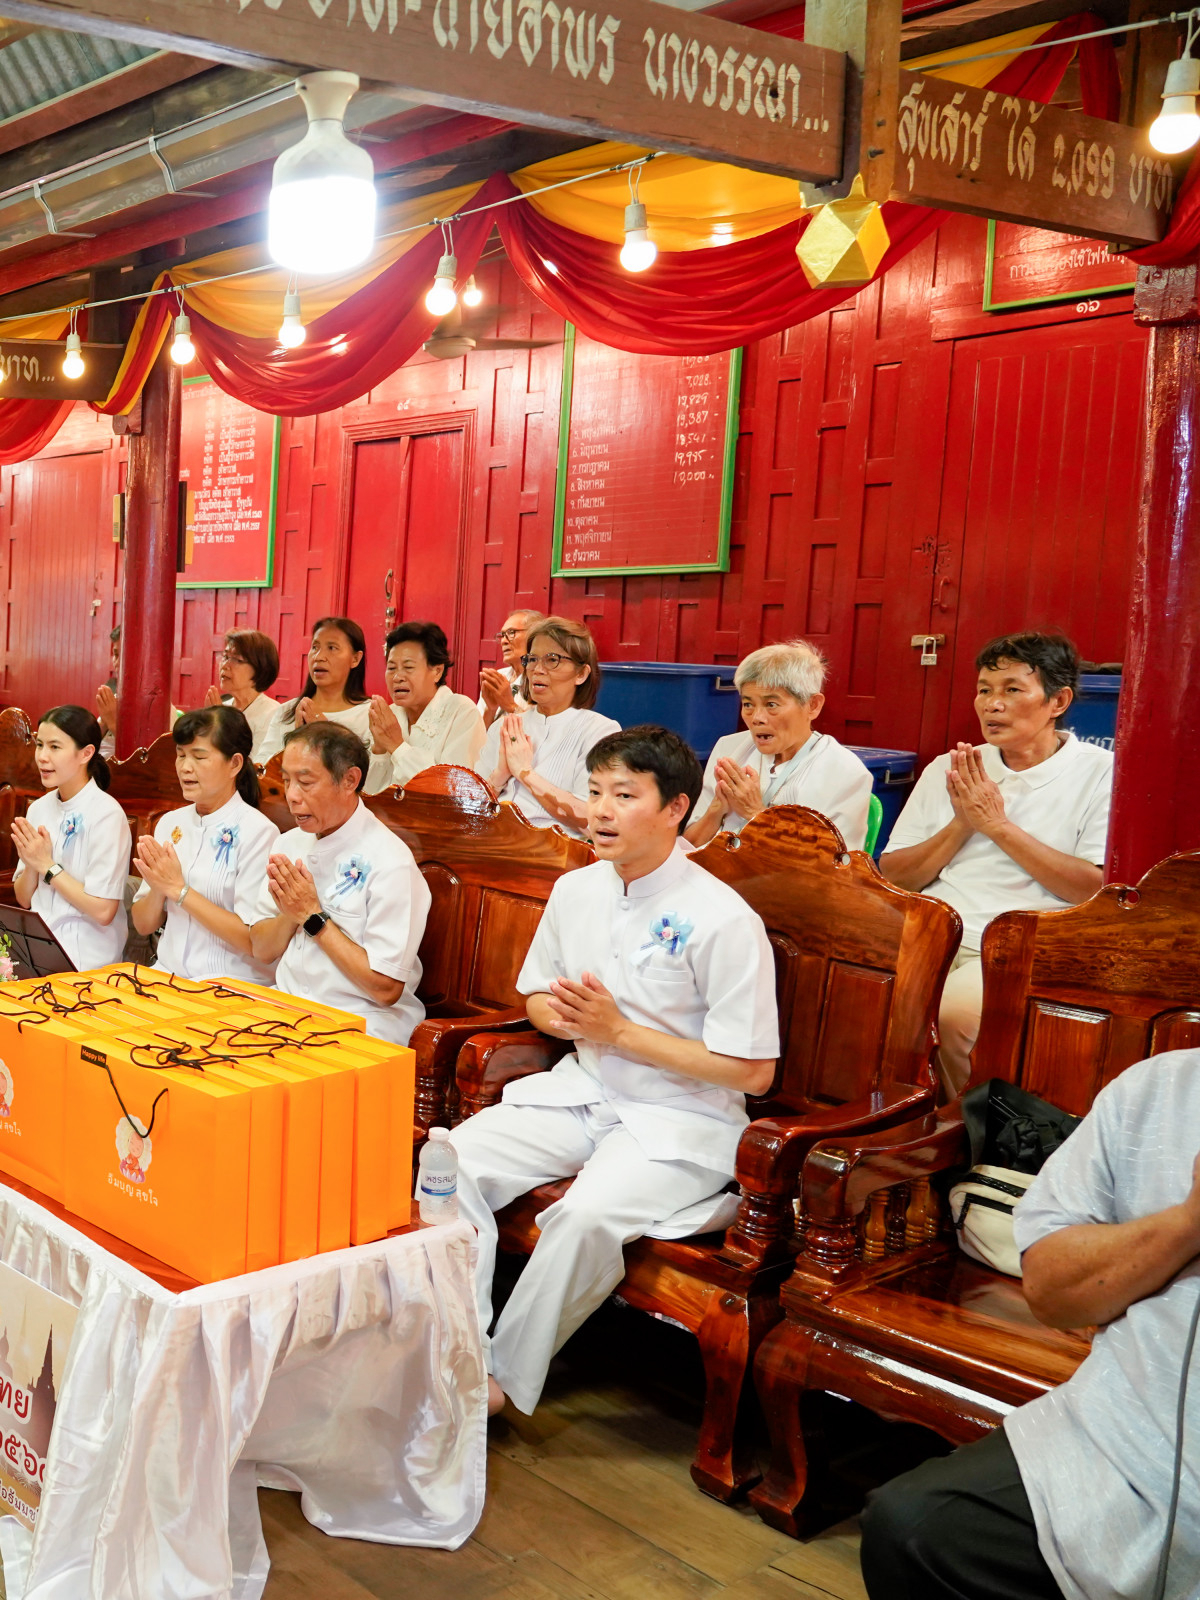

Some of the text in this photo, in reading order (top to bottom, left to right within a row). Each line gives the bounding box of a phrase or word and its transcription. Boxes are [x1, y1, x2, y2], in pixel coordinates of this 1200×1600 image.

[1001, 96, 1045, 182] ได้
[1128, 152, 1175, 214] บาท
[82, 1048, 106, 1064] Happy life
[136, 1187, 159, 1207] สุขใจ
